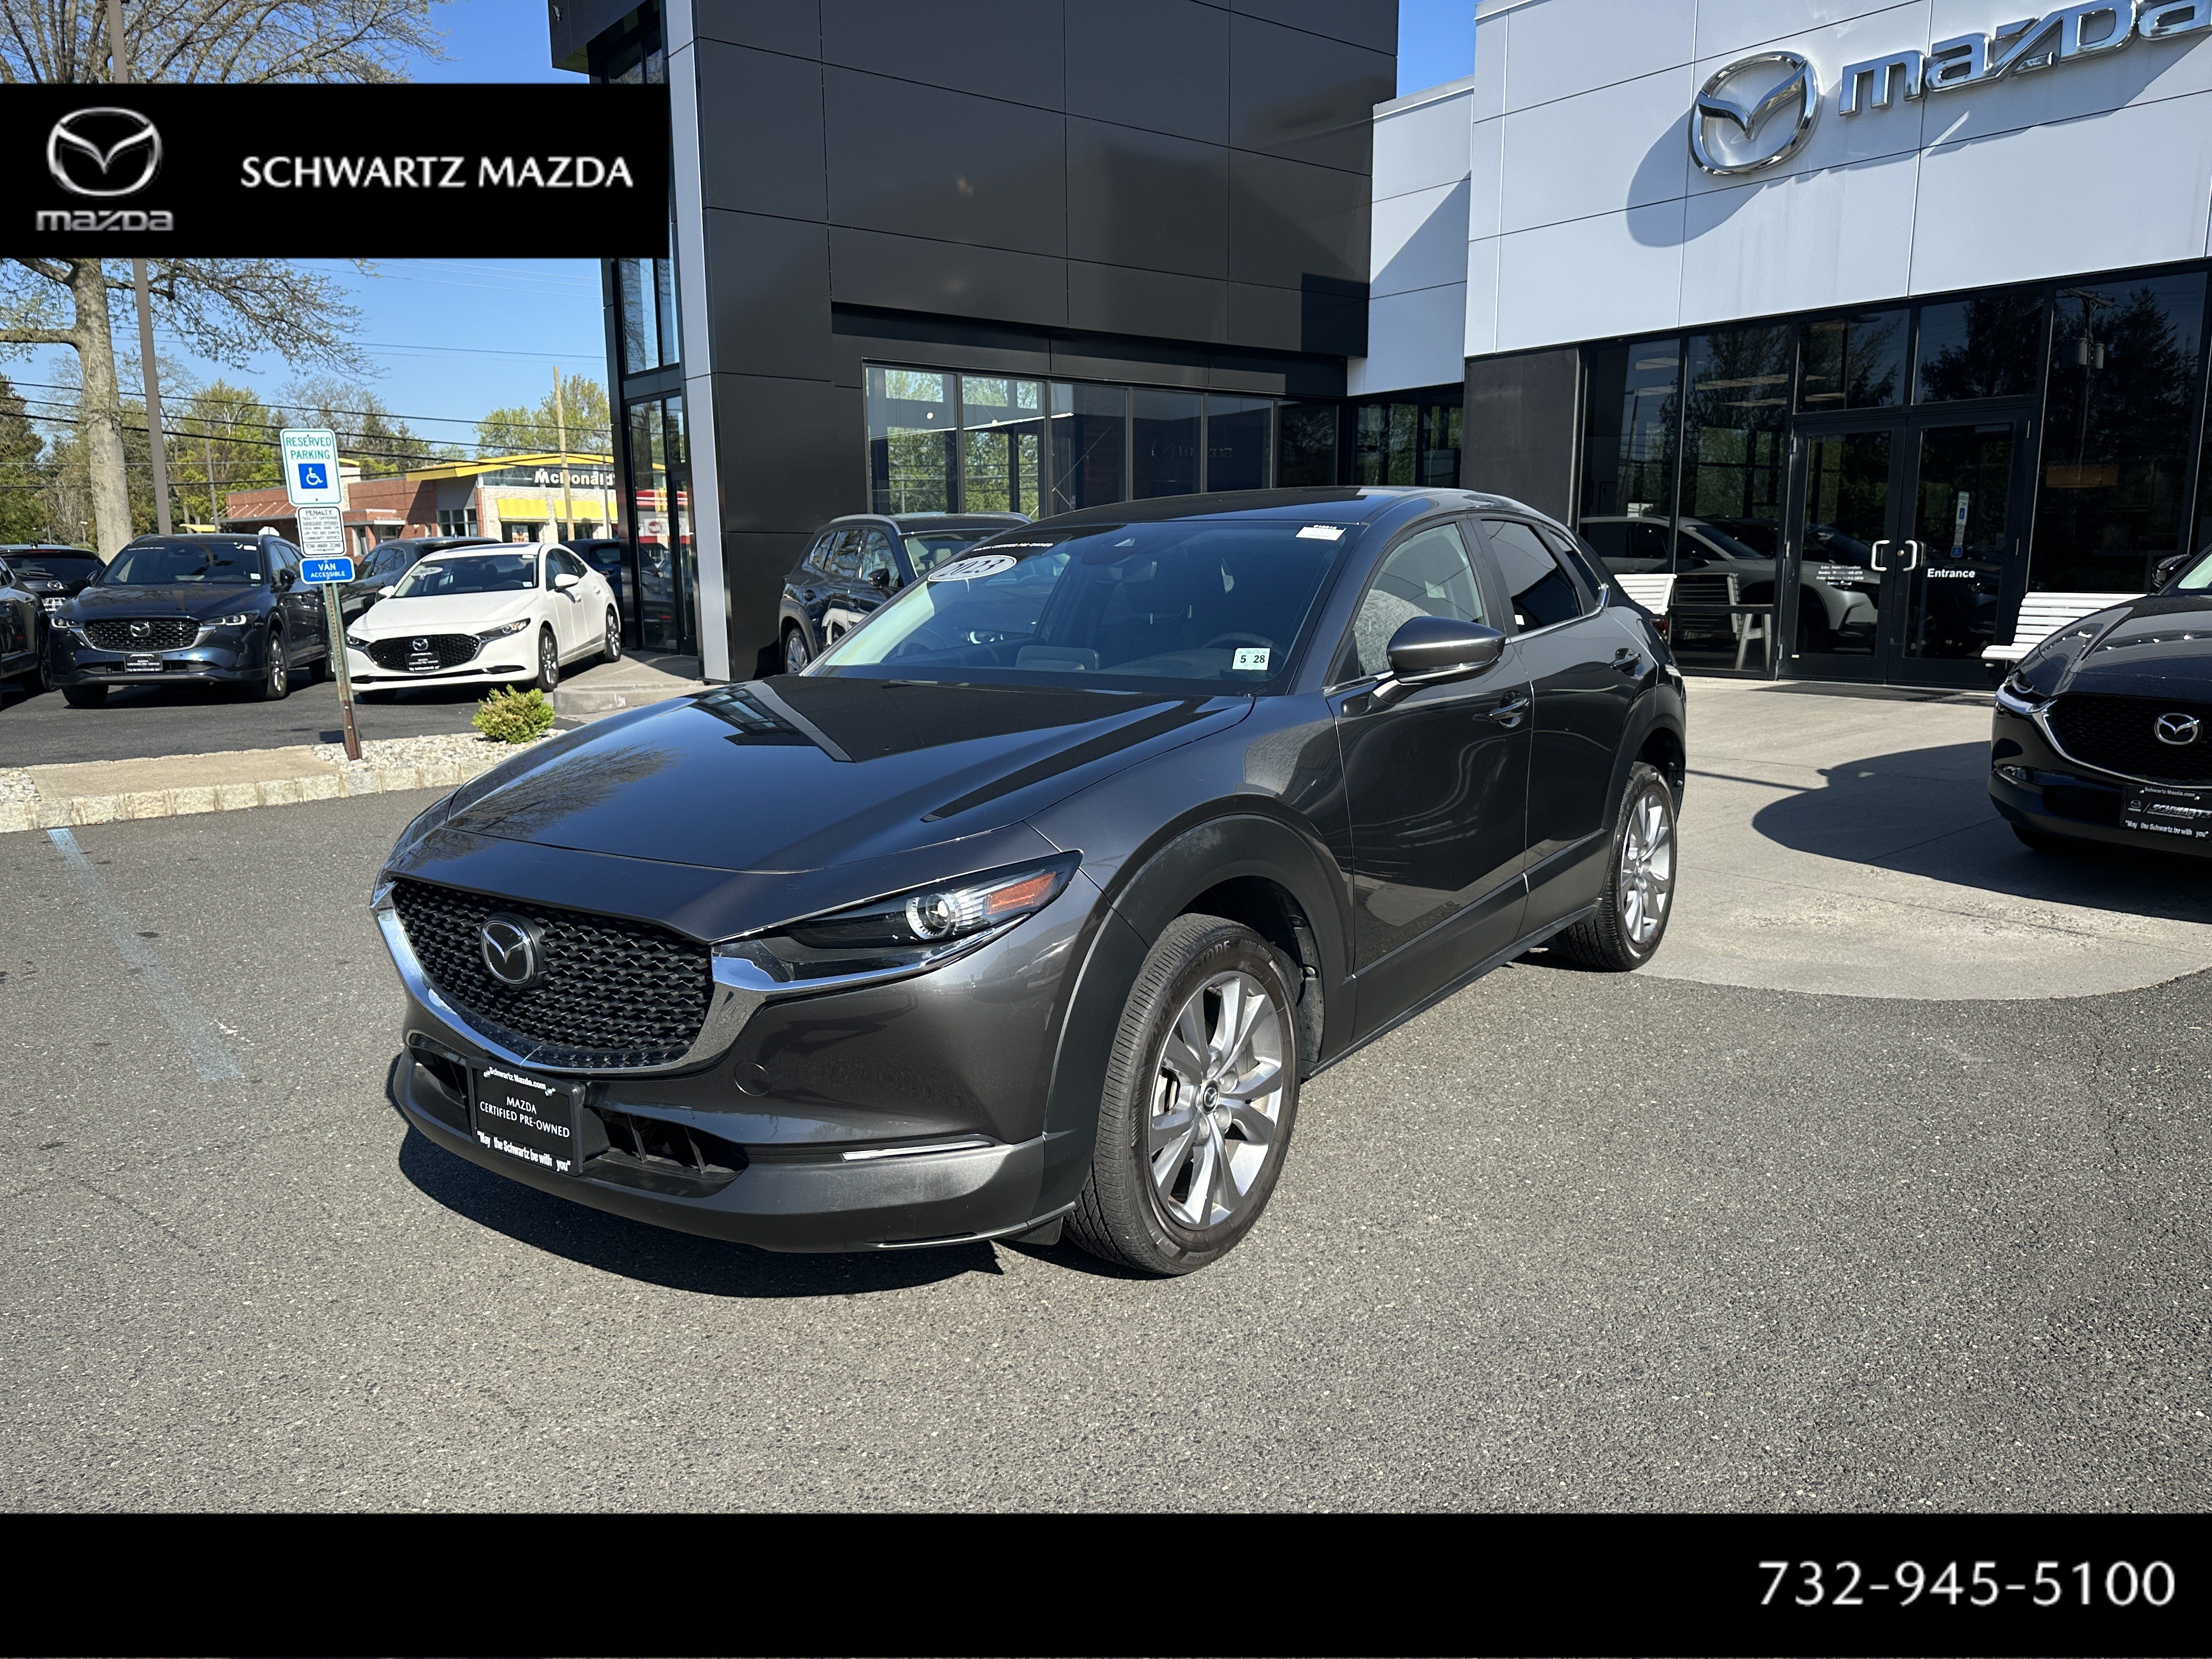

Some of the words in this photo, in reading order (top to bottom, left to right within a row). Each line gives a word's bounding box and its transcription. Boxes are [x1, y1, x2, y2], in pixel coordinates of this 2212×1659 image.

[1838, 0, 2212, 116] mazda
[286, 437, 332, 447] RESERVED
[291, 450, 330, 460] PARKING
[318, 562, 336, 571] VAN
[936, 558, 1006, 577] 2023
[1927, 568, 1975, 578] Entrance
[2149, 823, 2172, 833] Schwartz
[489, 1066, 514, 1081] Schwartz
[514, 1074, 546, 1090] Mazda.com
[506, 1096, 537, 1114] MAZDA
[480, 1102, 517, 1121] CERTIFIED
[520, 1114, 570, 1138] PRE-OWNED
[494, 1137, 503, 1150] the
[503, 1140, 530, 1159] Schwartz
[530, 1149, 538, 1162] be
[539, 1153, 552, 1166] with
